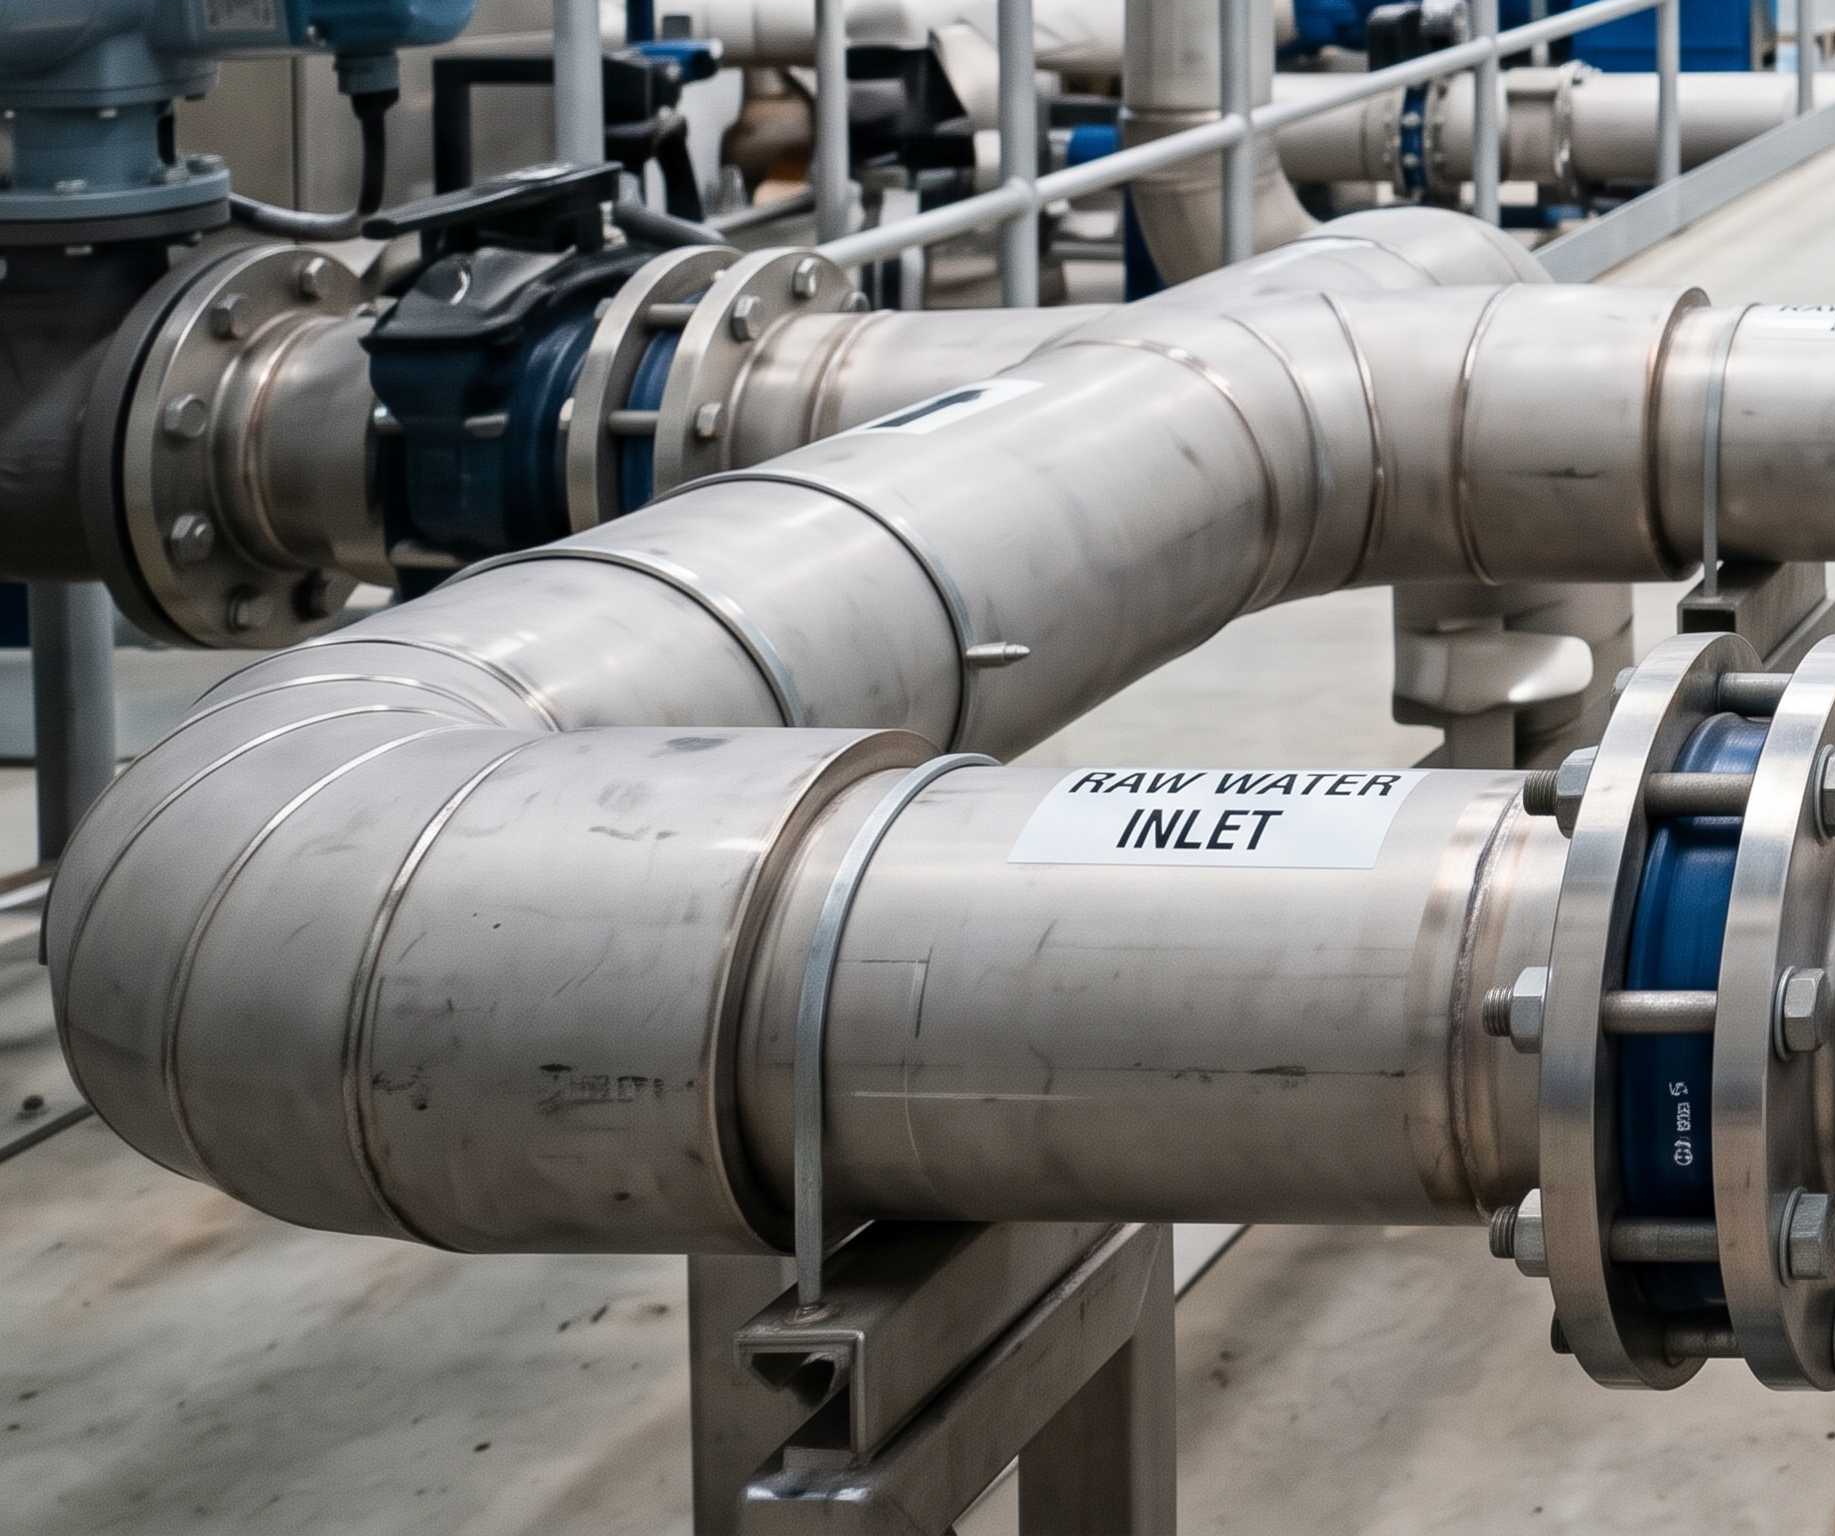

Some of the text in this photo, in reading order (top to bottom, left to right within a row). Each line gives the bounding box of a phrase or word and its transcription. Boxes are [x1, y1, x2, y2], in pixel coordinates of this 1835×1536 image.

[1068, 771, 1402, 796] RAW WATER
[1115, 808, 1284, 851] INLET
